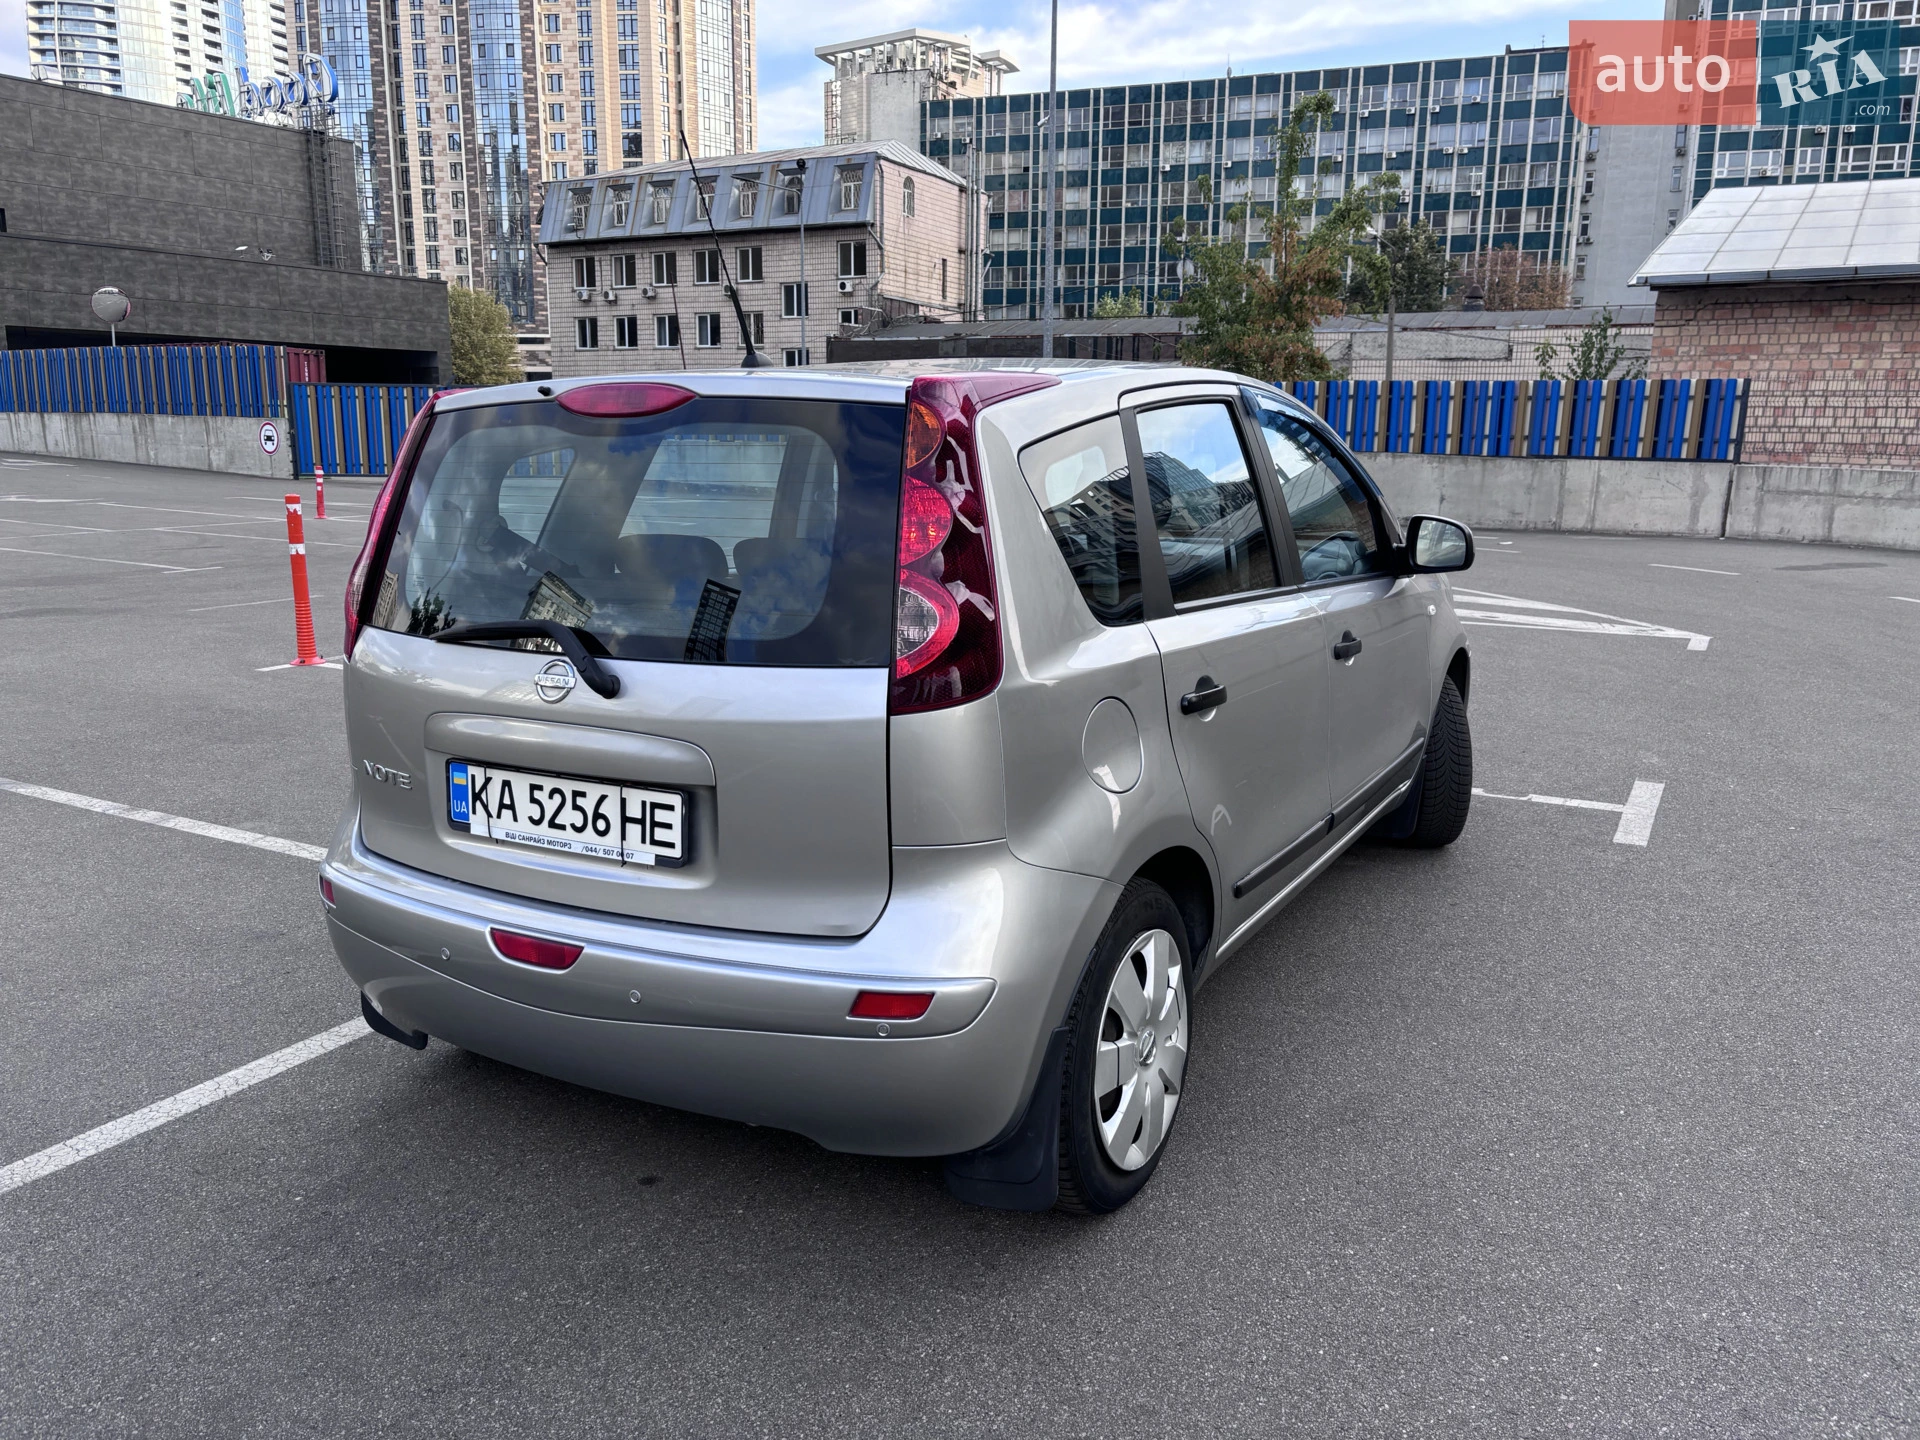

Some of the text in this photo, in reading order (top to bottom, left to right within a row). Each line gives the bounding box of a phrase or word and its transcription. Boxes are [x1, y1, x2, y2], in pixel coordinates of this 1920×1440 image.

[537, 674, 570, 686] NISSAN
[363, 759, 413, 790] NOTE
[453, 800, 468, 814] UA
[527, 782, 612, 838] 5256
[517, 833, 546, 846] САНРАЙЗ
[546, 838, 572, 850] МОТОРЗ
[602, 848, 615, 856] 507
[625, 852, 635, 860] 07
